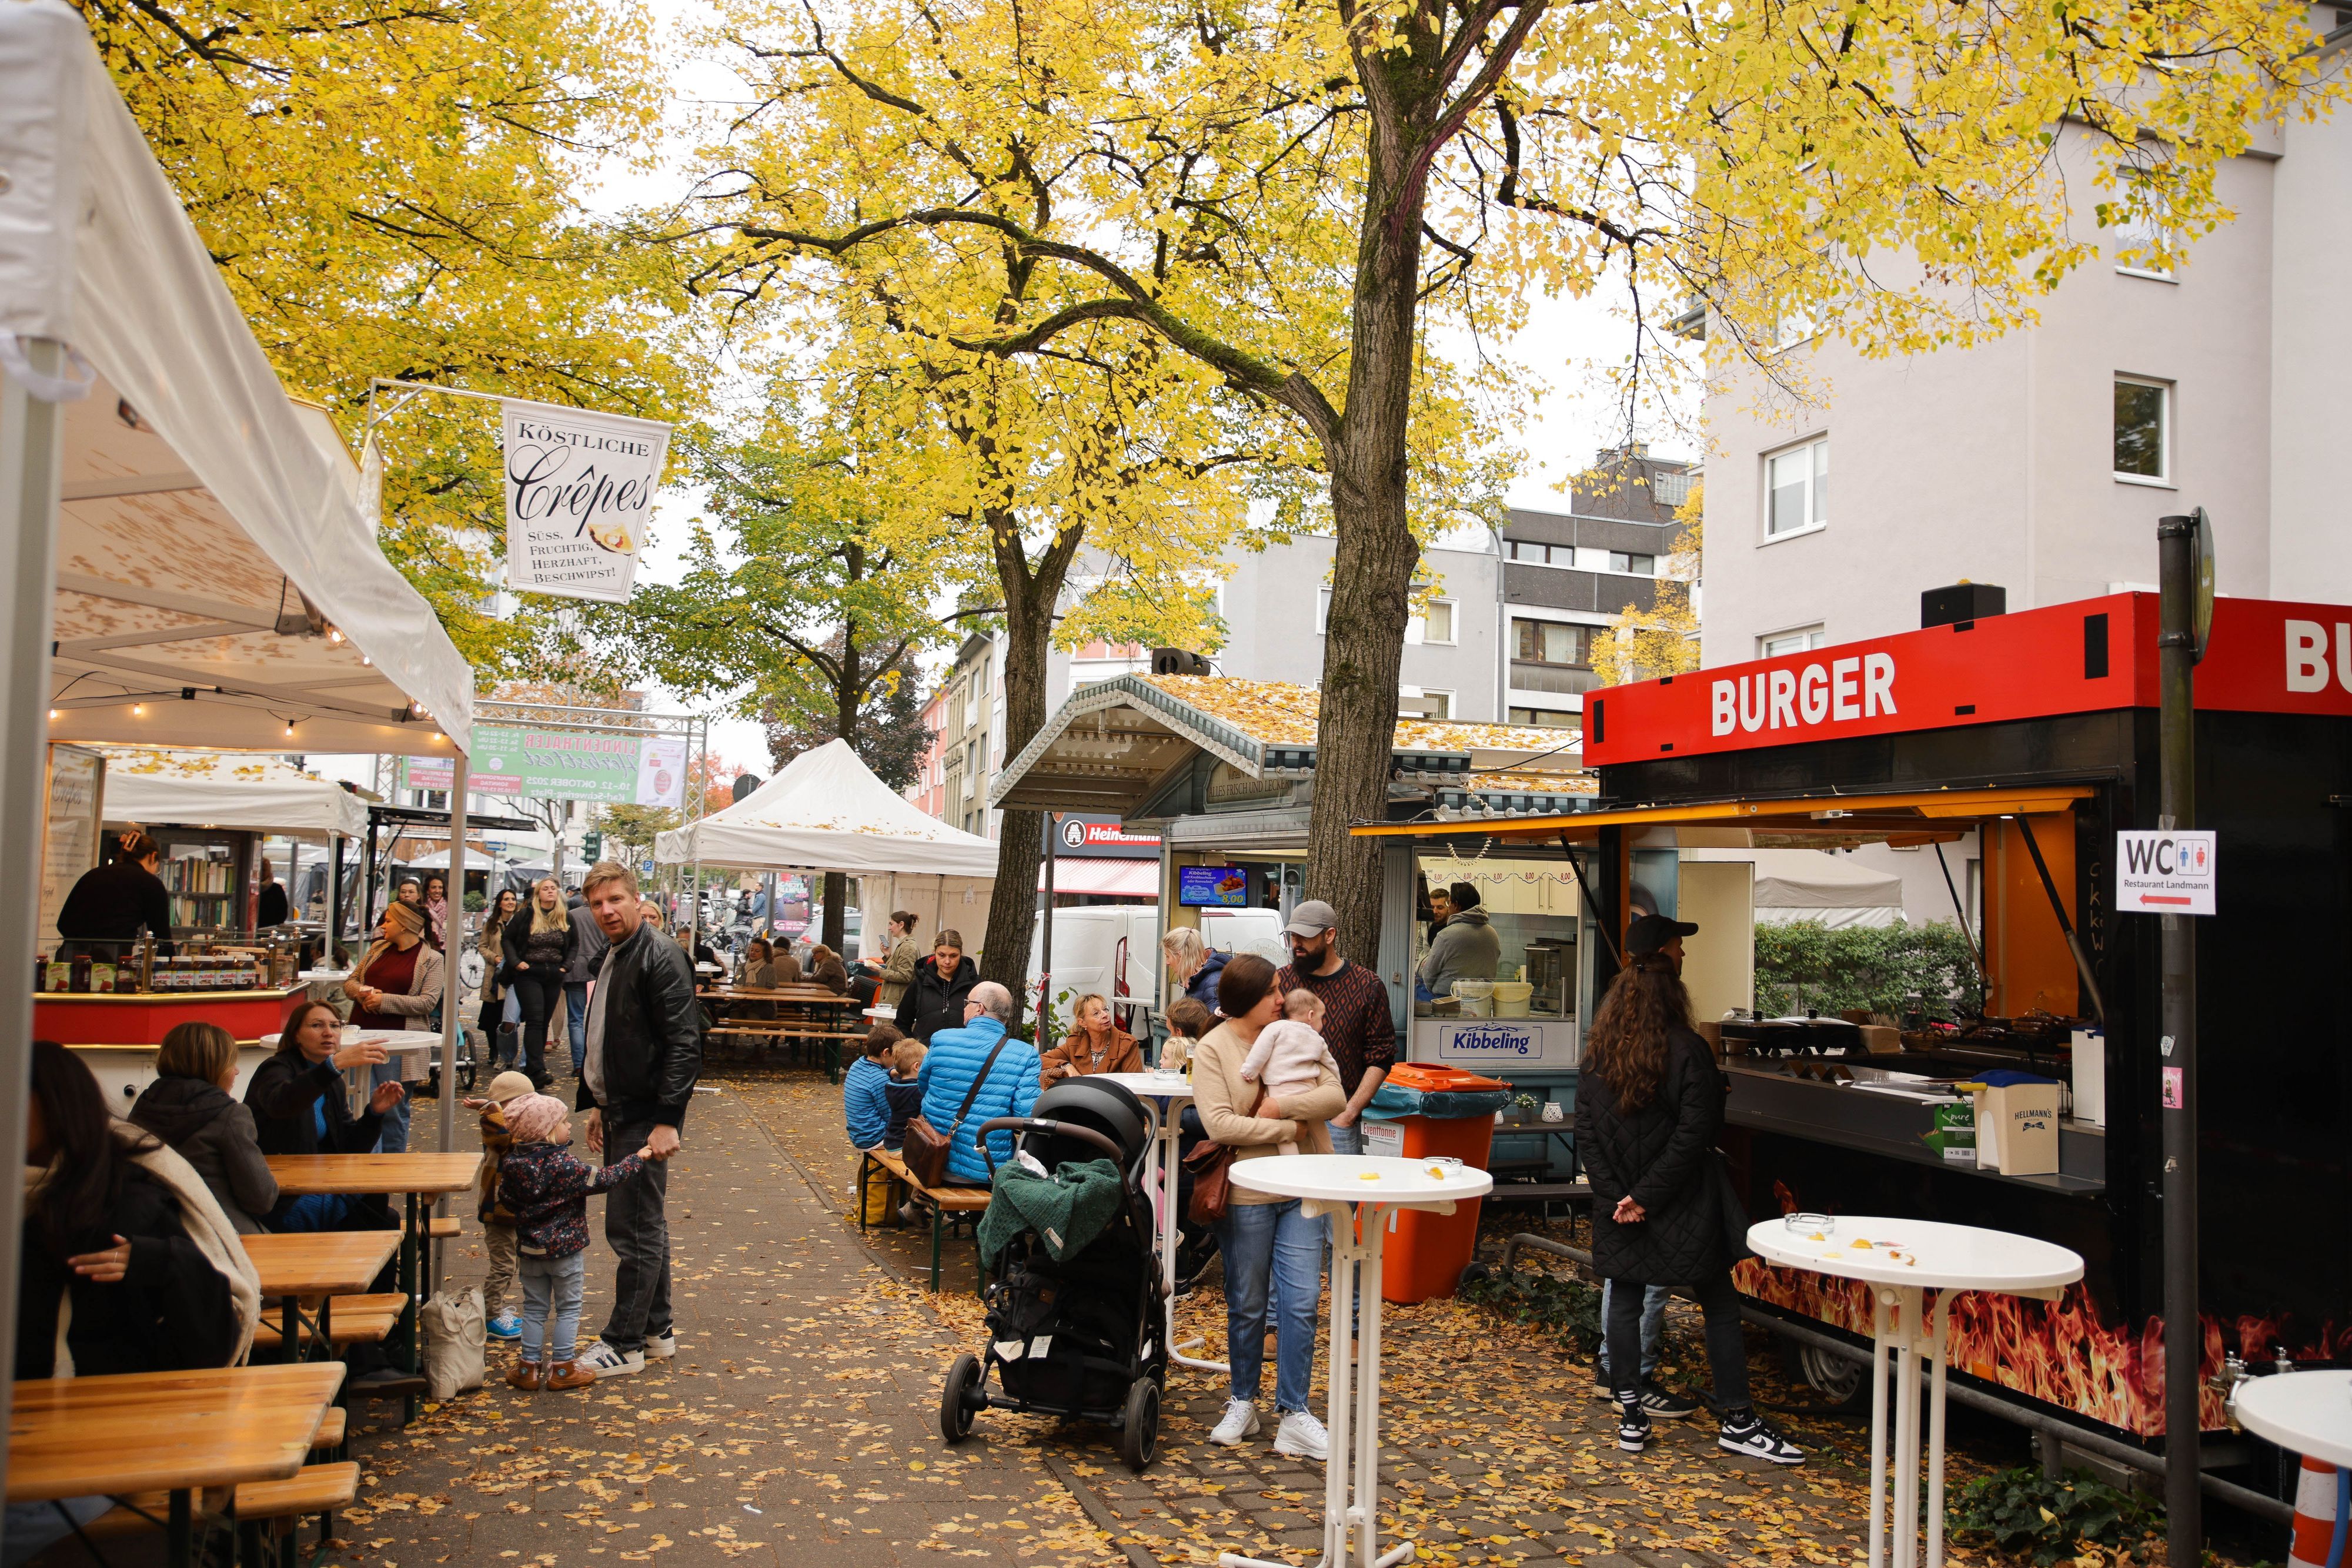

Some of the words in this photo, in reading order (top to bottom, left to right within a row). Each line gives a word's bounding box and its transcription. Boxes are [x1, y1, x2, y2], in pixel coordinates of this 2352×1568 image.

[517, 423, 649, 457] KÖSTLICHE
[509, 444, 651, 538] Crêpes
[1712, 652, 1898, 737] BURGER
[1208, 785, 1225, 797] ALLES
[1227, 782, 1247, 795] FRISCH
[1249, 780, 1263, 793] UND
[1265, 779, 1290, 792] LECKER
[2126, 839, 2174, 875] WC
[2124, 880, 2164, 888] Restaurant
[2167, 881, 2209, 890] Landmann
[1222, 894, 1244, 905] 8,00
[1453, 1032, 1530, 1054] Kibbeling
[1949, 1114, 1970, 1124] pure
[2014, 1108, 2052, 1120] HELLMANN'S
[1364, 1122, 1396, 1138] Eventtonne
